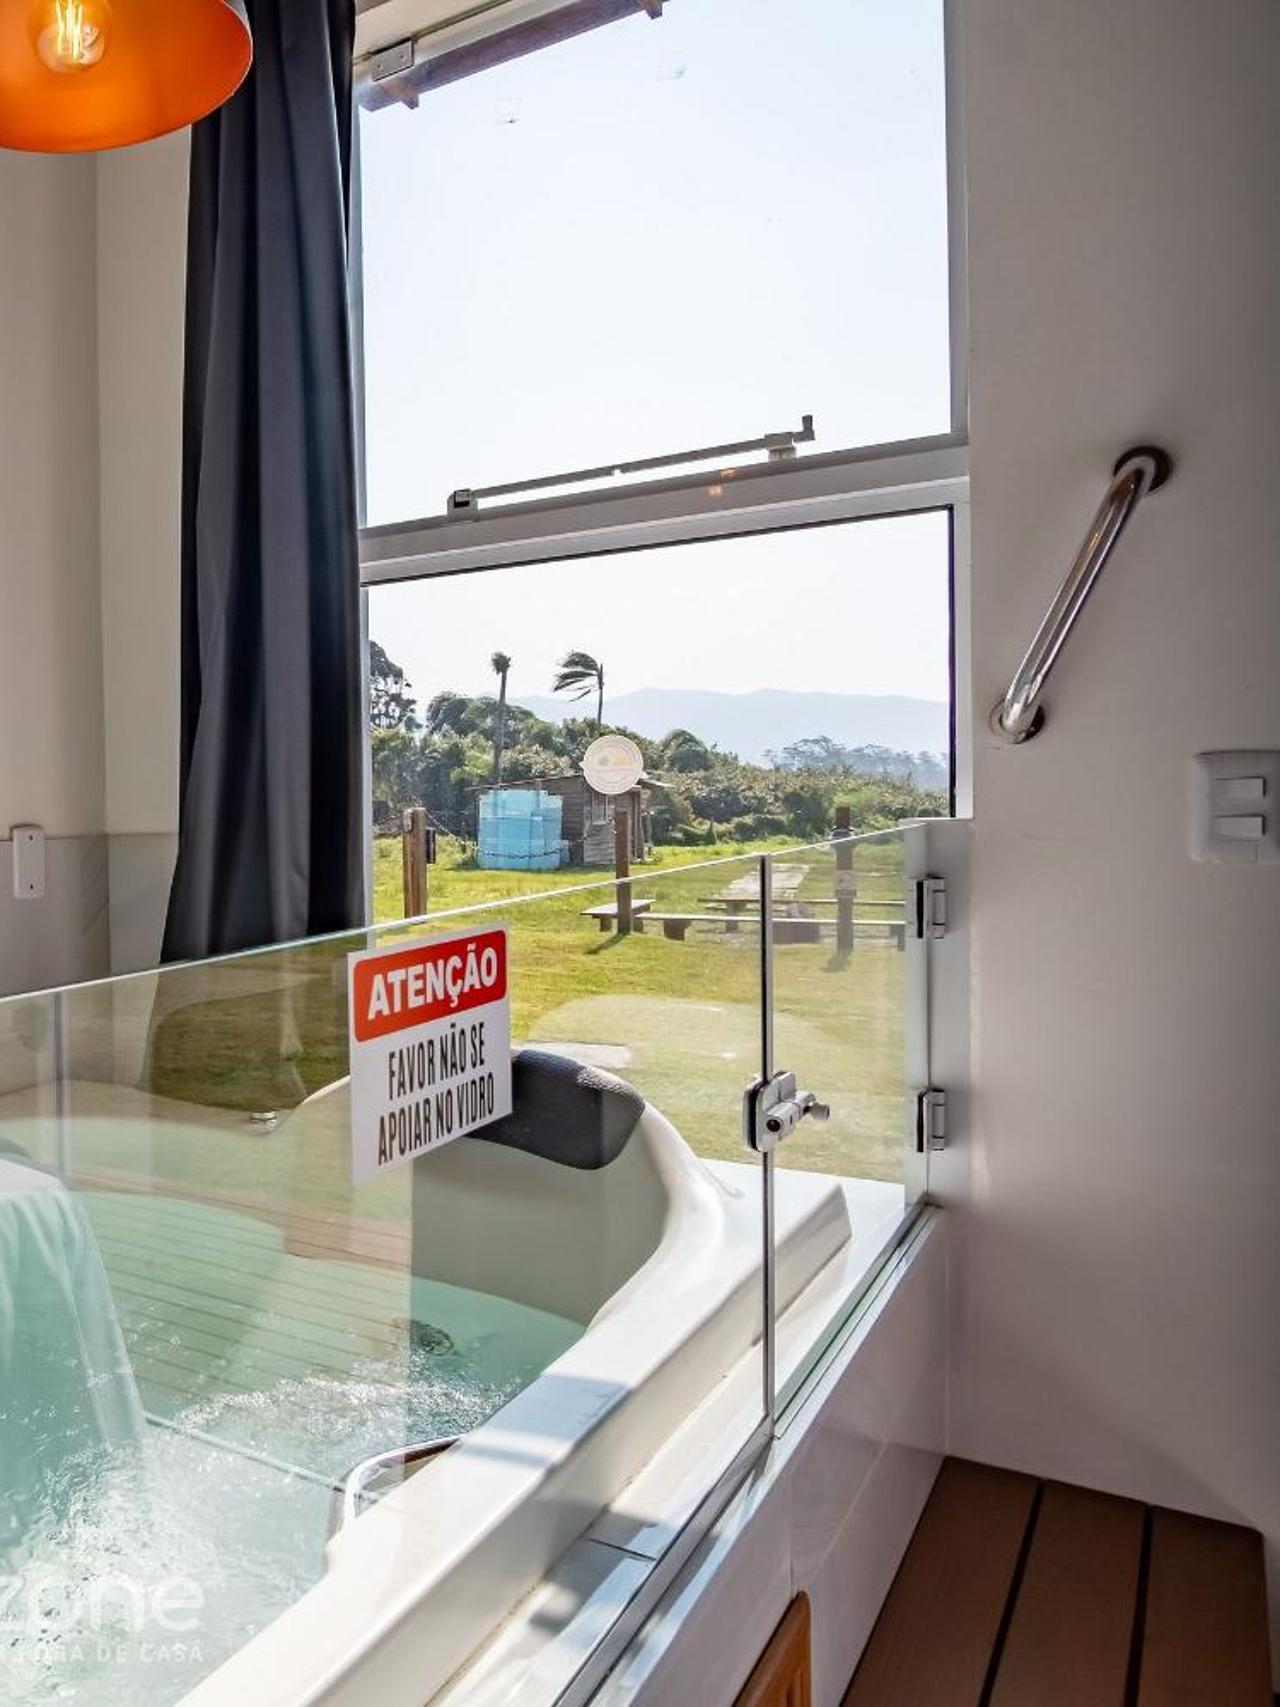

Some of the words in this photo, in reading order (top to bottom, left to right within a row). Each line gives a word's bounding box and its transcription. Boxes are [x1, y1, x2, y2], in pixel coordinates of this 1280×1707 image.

[368, 943, 497, 1020] ATENÇÃO
[389, 1037, 436, 1100] FAVOR
[440, 1022, 467, 1081] NÃO
[470, 1022, 485, 1067] SE
[378, 1098, 431, 1165] APOIAR
[436, 1085, 454, 1139] NO
[456, 1072, 494, 1128] VIDRO
